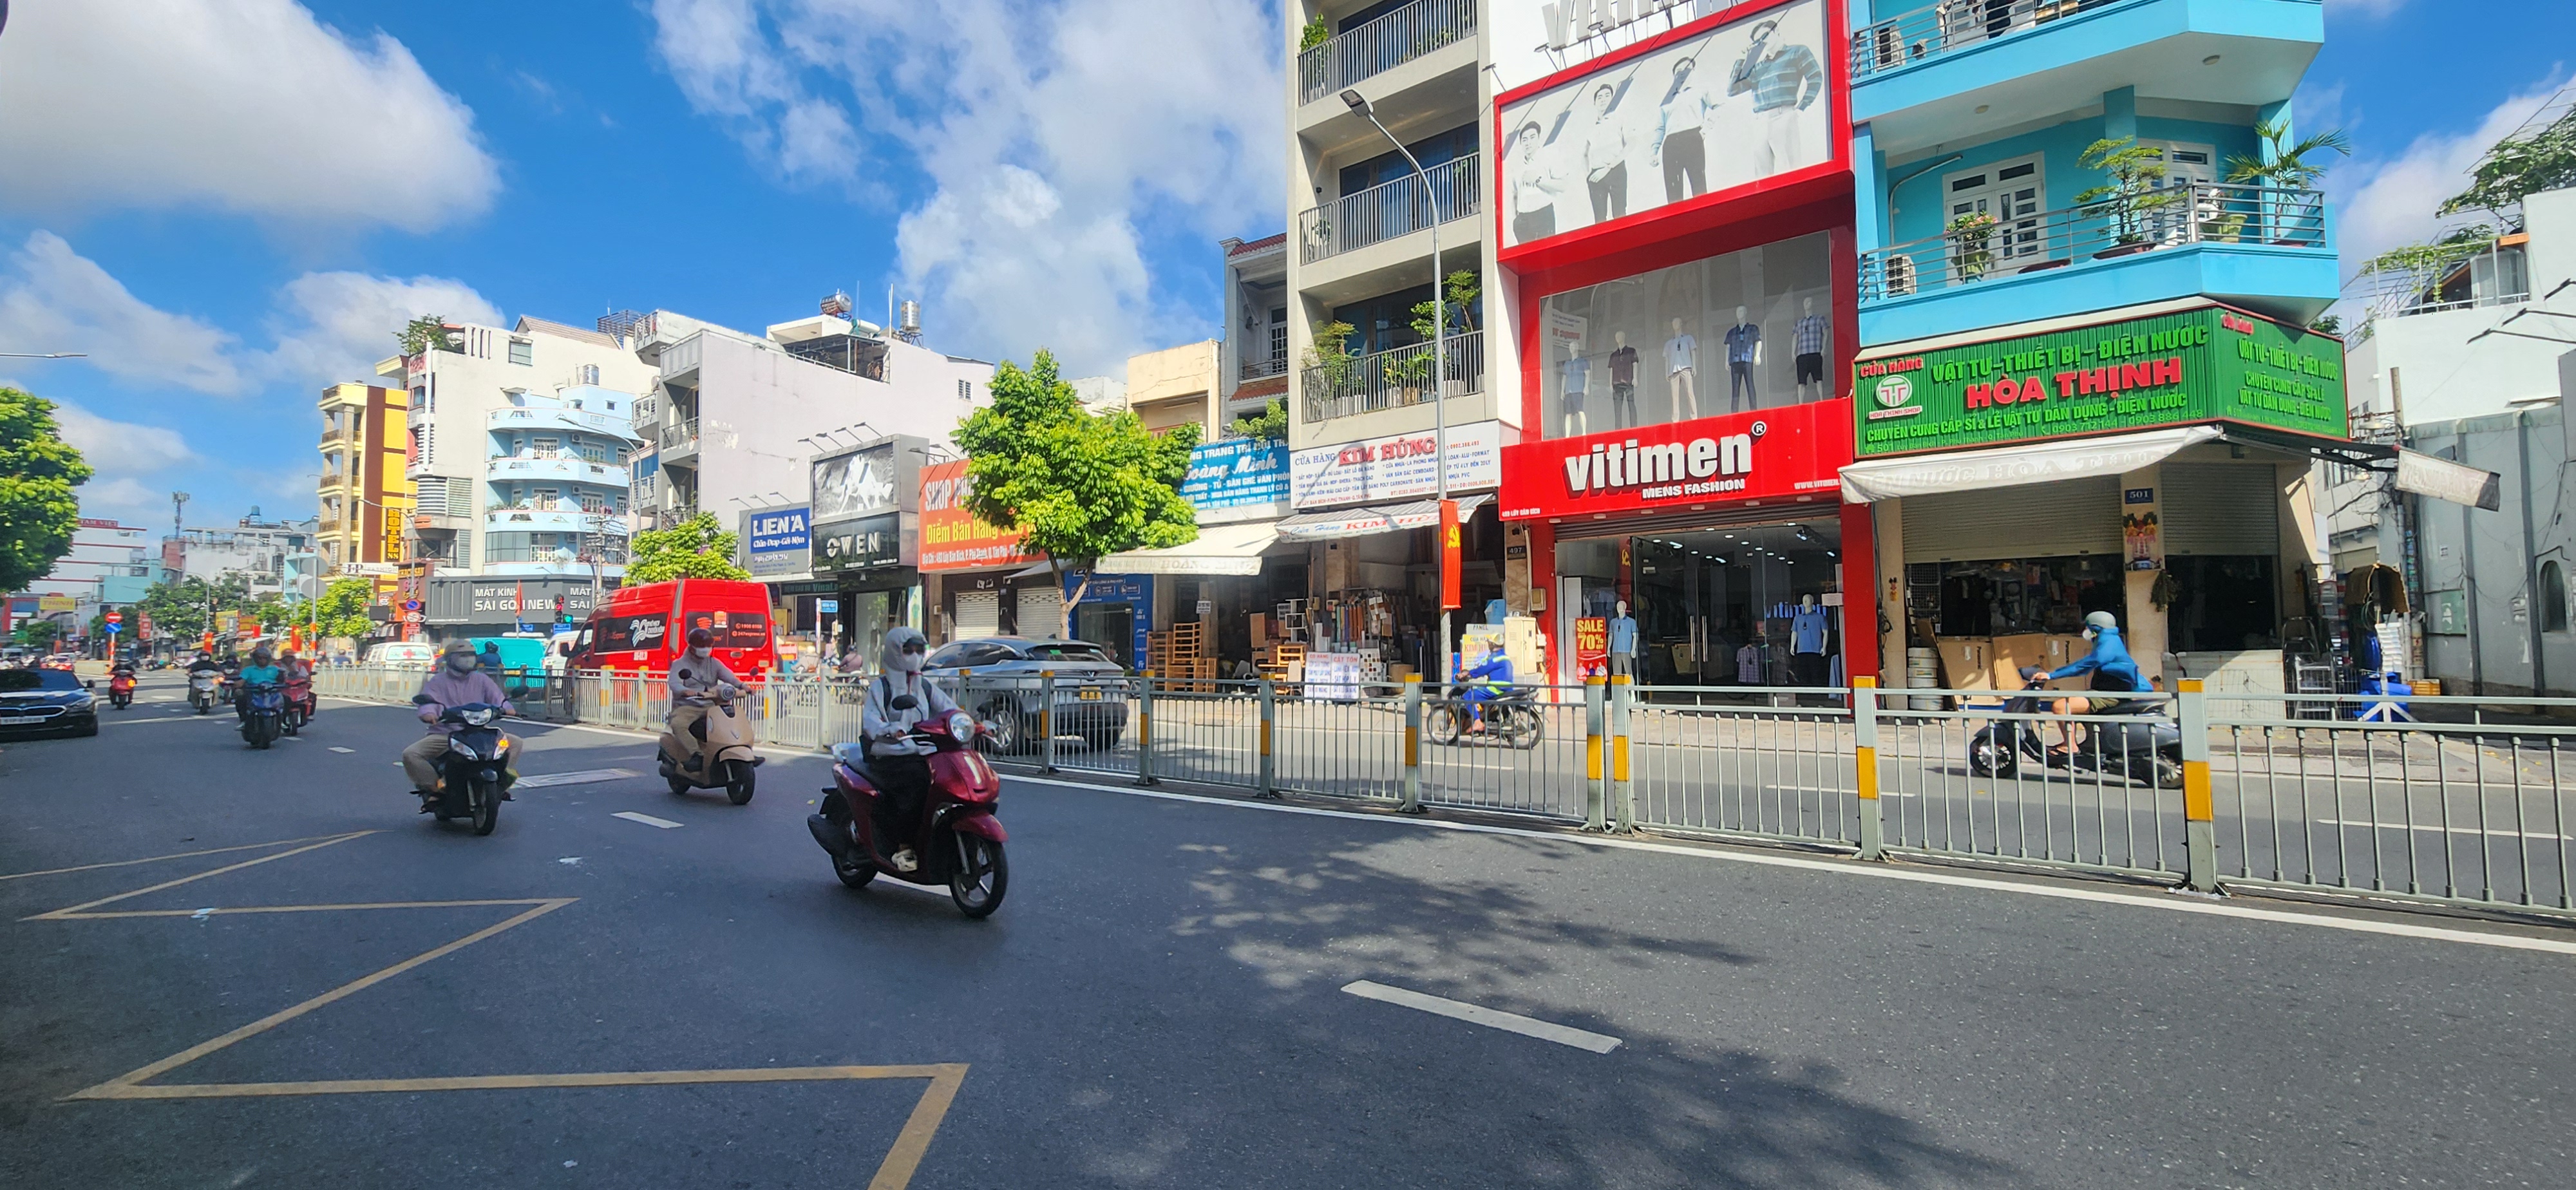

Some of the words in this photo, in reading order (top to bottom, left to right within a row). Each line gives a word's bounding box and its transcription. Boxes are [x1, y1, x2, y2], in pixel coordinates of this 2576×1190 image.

[1933, 359, 1965, 385] VẬT
[2061, 344, 2081, 366] BỊ
[2098, 334, 2146, 361] ĐIỆN
[2151, 322, 2210, 352] NƯỚC
[1860, 360, 1886, 378] CỬA
[1889, 357, 1924, 373] HÀNG
[1967, 373, 2047, 409] HÒA
[2054, 356, 2182, 399] THỊNH
[1868, 424, 1908, 442] CHUYÊN
[1910, 424, 1939, 438] CUNG
[1940, 415, 1962, 434] CẤP
[1978, 418, 1985, 430] &
[2003, 411, 2022, 430] VẬT
[2025, 408, 2041, 424] TƯ
[2045, 405, 2070, 422] DÂN
[2074, 402, 2107, 421] DỤNG
[2116, 395, 2146, 415] ĐIỆN
[2150, 388, 2187, 410] NƯỚC
[2052, 422, 2077, 433] 0903
[2080, 420, 2098, 430] 712
[2129, 414, 2155, 424] 0903
[2158, 411, 2179, 422] 886
[2182, 409, 2204, 419] 448
[1204, 446, 1235, 458] TRANG
[1294, 454, 1311, 466] CỬA
[1313, 452, 1336, 464] HÀNG
[1338, 445, 1376, 468] KIM
[1877, 443, 1894, 452] 501
[1233, 453, 1278, 475] Minh
[1565, 433, 1752, 492] vitimen
[1226, 477, 1242, 487] BÀN
[1273, 471, 1290, 482] PHÒN
[1642, 484, 1682, 499] MENS
[1684, 478, 1746, 495] FASHION
[925, 478, 952, 512] SHOP
[2129, 490, 2149, 498] 501
[926, 518, 950, 545] Điểm
[952, 519, 971, 542] Bán
[826, 531, 881, 558] OWEN
[475, 585, 495, 598] MẮT
[570, 585, 591, 597] MẮT
[474, 598, 497, 612] SÀI
[499, 598, 526, 611] GÒ
[569, 598, 591, 610] SÀI
[1577, 619, 1604, 632] SALE
[1577, 634, 1604, 650] 70%
